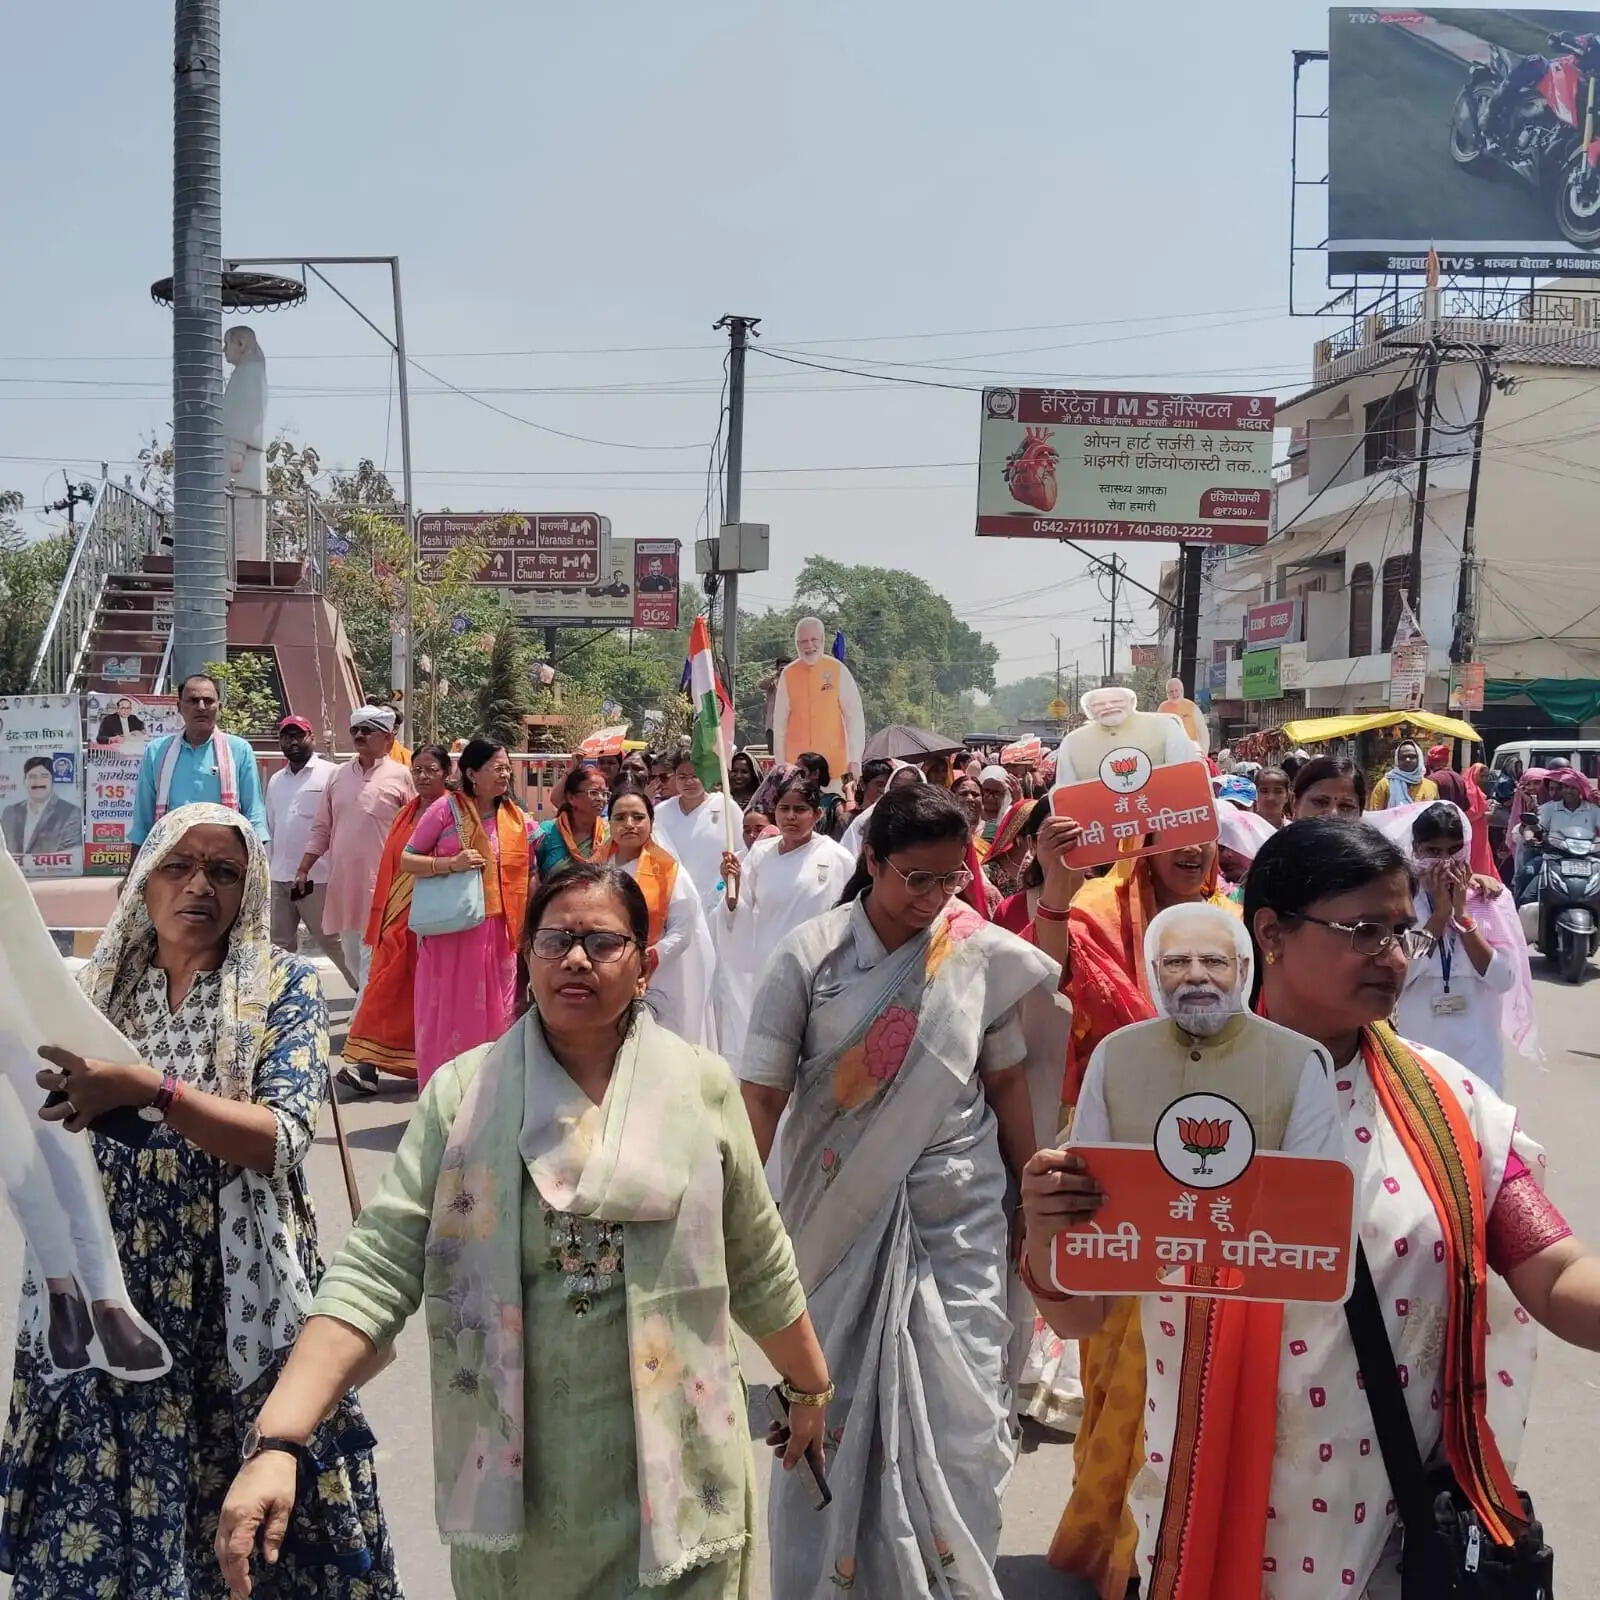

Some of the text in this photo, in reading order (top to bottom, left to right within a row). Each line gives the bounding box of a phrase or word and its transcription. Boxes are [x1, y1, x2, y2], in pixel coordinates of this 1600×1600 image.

[1348, 13, 1377, 24] TVS
[1387, 256, 1428, 270] अग्रवा
[1440, 257, 1474, 270] TVS
[1040, 390, 1098, 413] हेरिटेज
[1162, 394, 1232, 418] हॉस्पिटल
[1084, 431, 1254, 453] ओपन हार्ट सर्जरी से लेकर
[1083, 451, 1129, 470] प्राइमरी
[1099, 484, 1167, 495] स्वास्थ्य आपका
[1108, 499, 1156, 512] सेवा हमारी
[1033, 520, 1212, 538] 0542-7111071, 740-860-2222
[422, 535, 442, 546] Kashi
[540, 534, 574, 546] Varanasi
[586, 537, 595, 546] km
[538, 553, 558, 564] किला
[499, 570, 508, 578] km
[517, 568, 545, 579] Chunar
[549, 568, 566, 579] Fort
[642, 608, 670, 621] 90%
[148, 723, 163, 733] 14
[1114, 797, 1129, 813] मैं
[1112, 819, 1139, 839] का
[1146, 805, 1211, 832] परिवार
[1168, 1191, 1198, 1221] मैं
[1065, 1219, 1340, 1272] मोदी का परिवार
